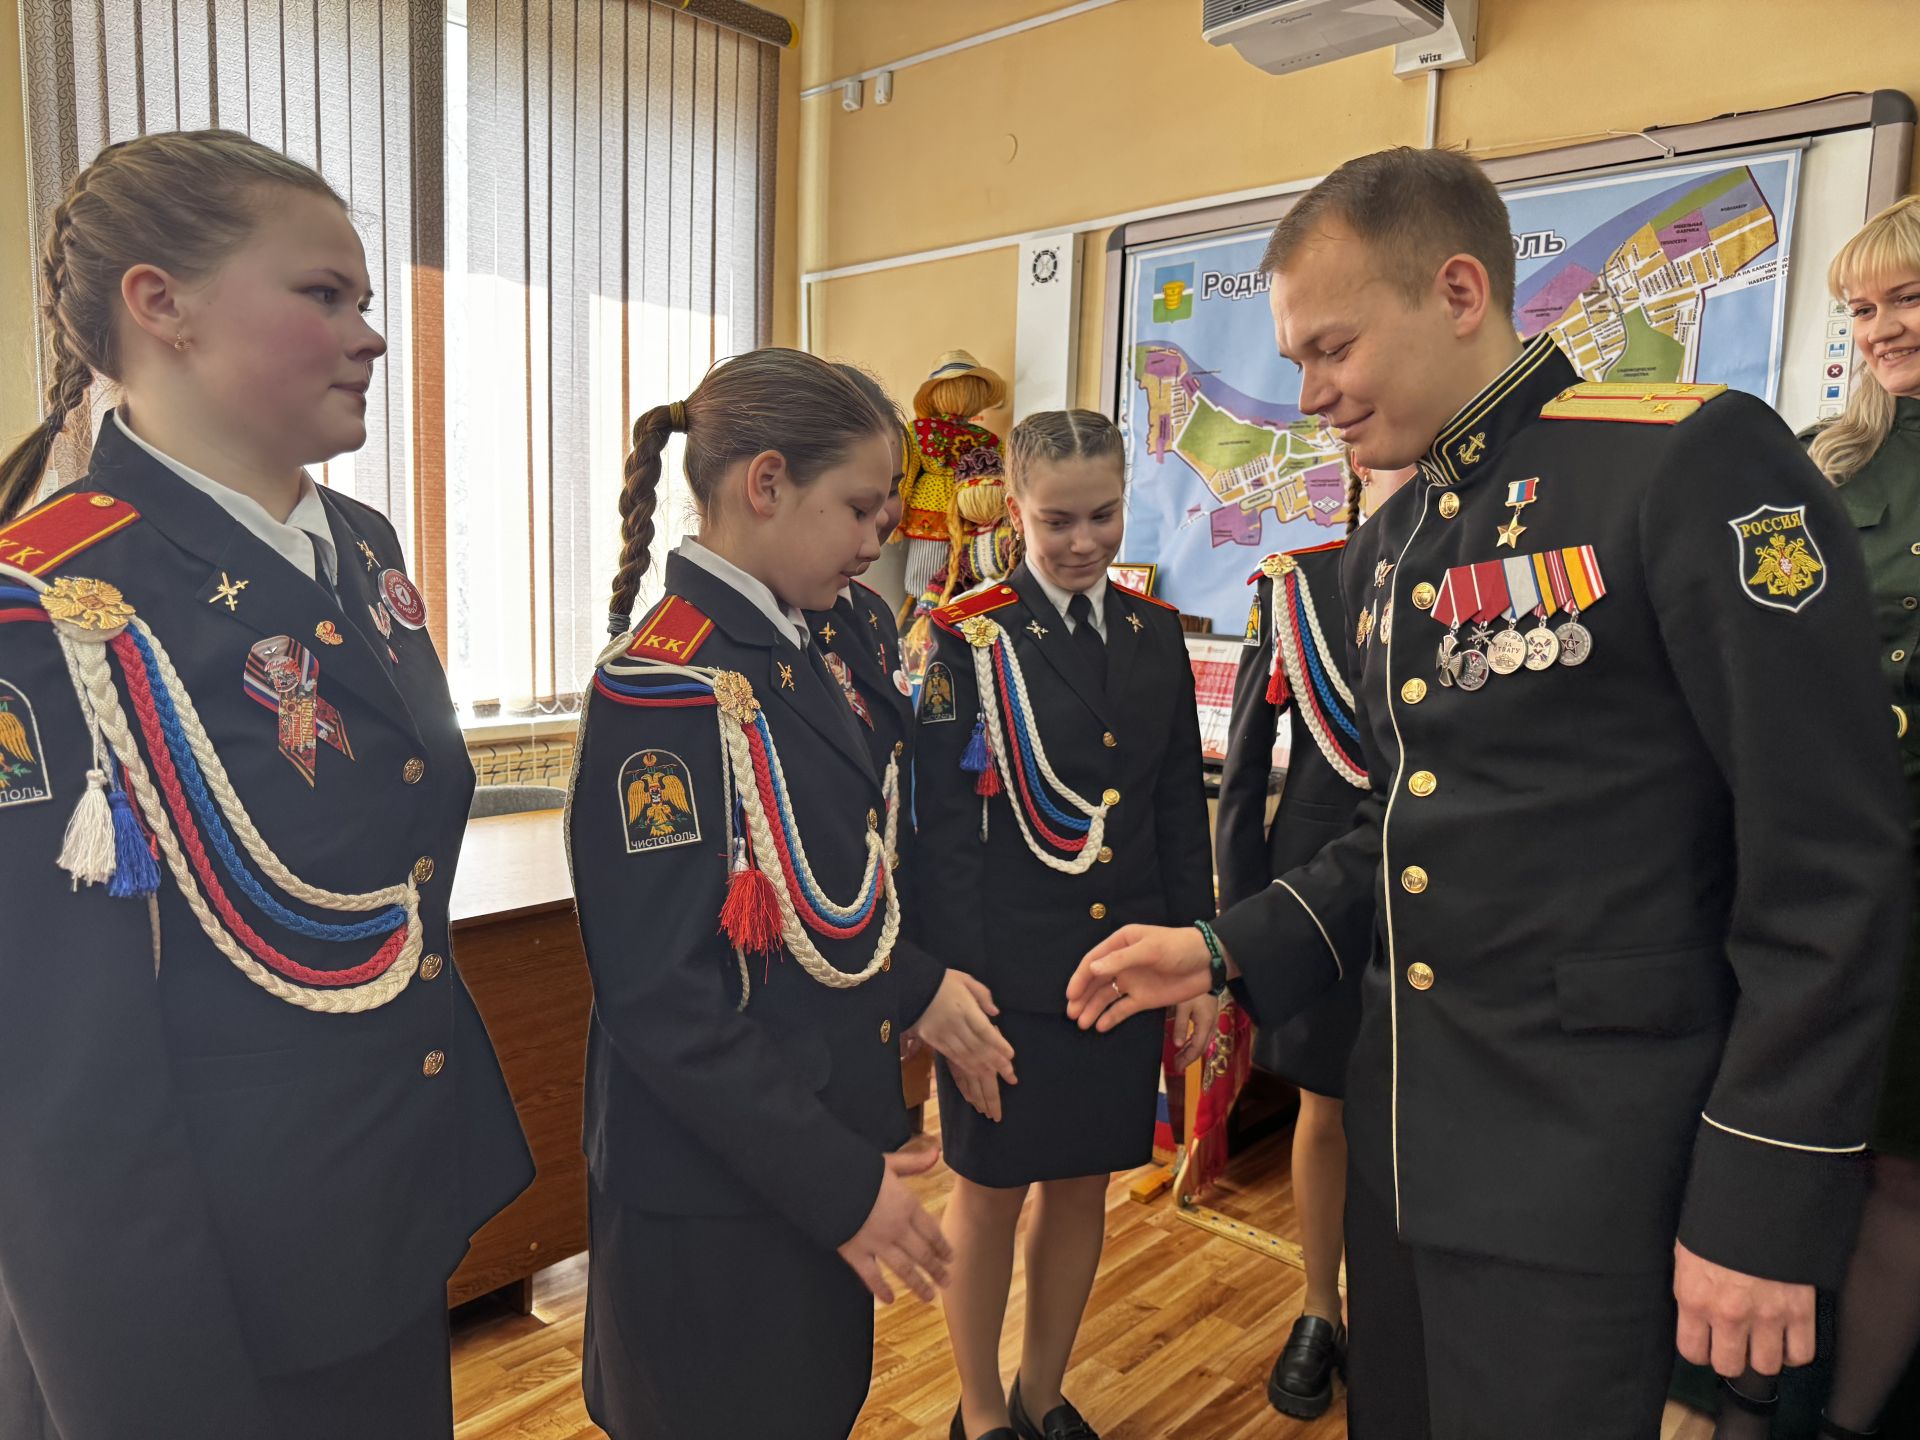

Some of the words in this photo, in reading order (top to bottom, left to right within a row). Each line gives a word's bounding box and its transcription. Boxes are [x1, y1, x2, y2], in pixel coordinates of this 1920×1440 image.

[1201, 270, 1273, 301] Родн
[1739, 513, 1802, 538] РОССИЯ
[642, 634, 686, 653] КК
[631, 831, 697, 849] ЧИСТОПОЛЬ
